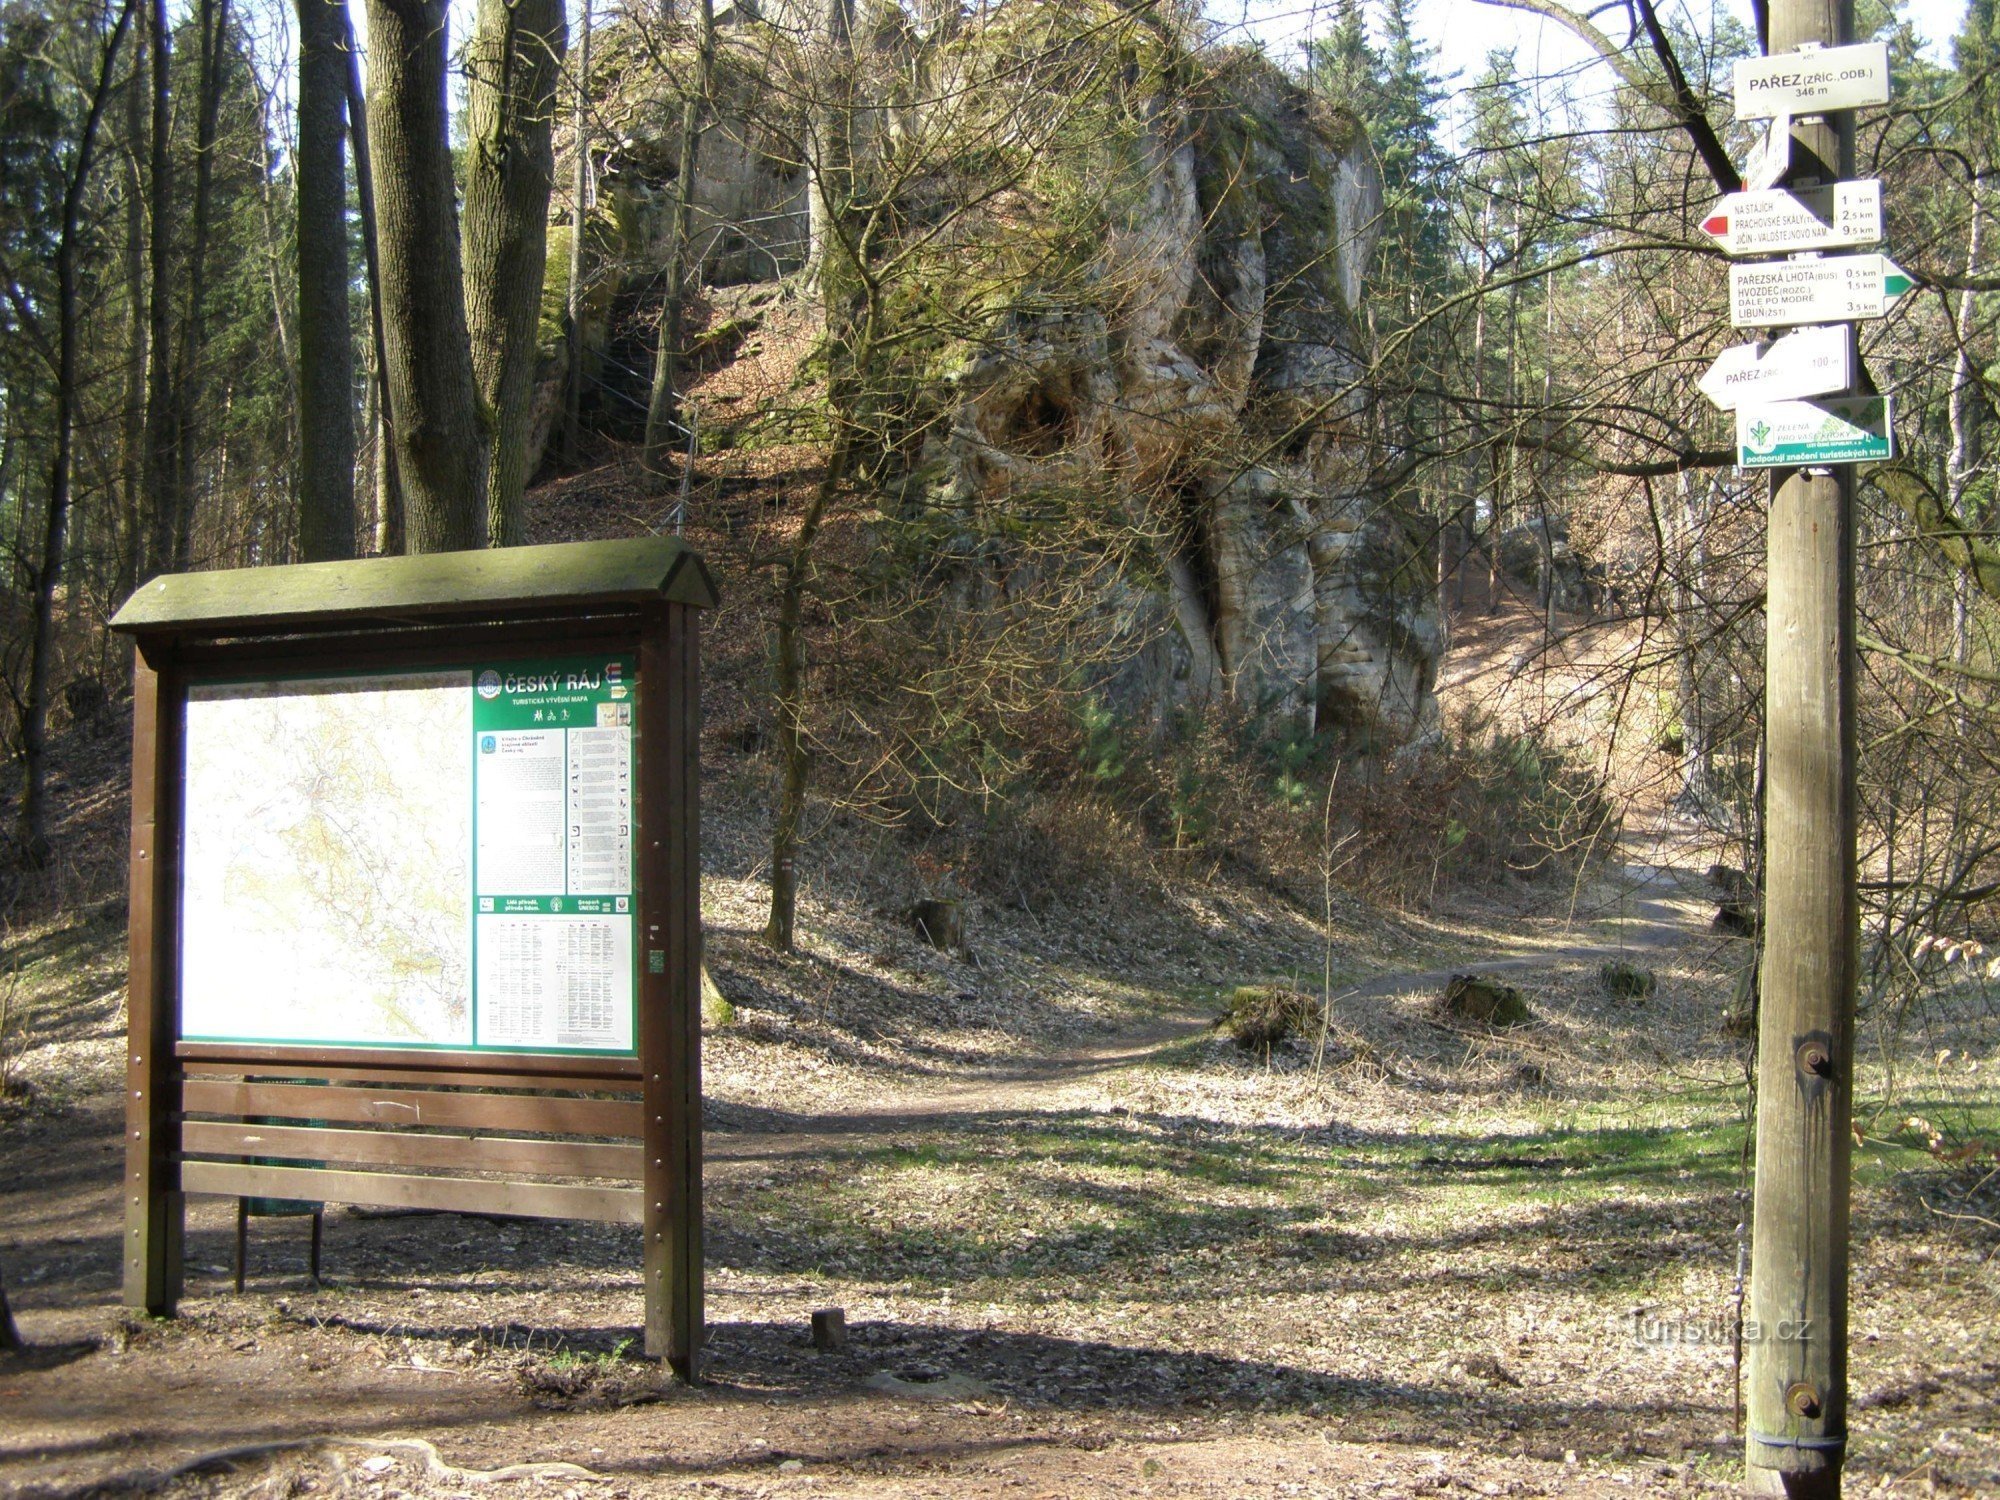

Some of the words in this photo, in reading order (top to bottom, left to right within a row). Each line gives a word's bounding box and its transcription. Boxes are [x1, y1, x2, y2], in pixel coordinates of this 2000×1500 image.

[1750, 74, 1802, 91] PAŘEZ
[1796, 89, 1814, 98] 346
[1842, 196, 1848, 205] 1
[1735, 205, 1745, 214] NA
[1736, 213, 1780, 230] PRACHOVSKÉ
[1736, 232, 1752, 244] JIČÍN
[1758, 228, 1810, 242] VALDŠTEJNOVO
[1738, 272, 1783, 286] PAŘEZSKÁ
[1786, 272, 1814, 282] LHOTA
[1738, 286, 1779, 298] HVOZDEC
[1781, 294, 1814, 304] MODRÉ
[1738, 306, 1765, 318] LIBUŇ
[1812, 356, 1828, 368] 100
[1726, 368, 1760, 384] PAŘEZ
[1820, 431, 1850, 439] KROKY
[1746, 455, 1785, 464] podporují
[1787, 452, 1817, 461] značení
[1820, 449, 1868, 459] turistických
[505, 670, 560, 694] ČESKÝ
[567, 669, 600, 690] RÁJ
[512, 696, 544, 705] TURISTICKÁ
[545, 695, 570, 704] VÝVĚSNÍ
